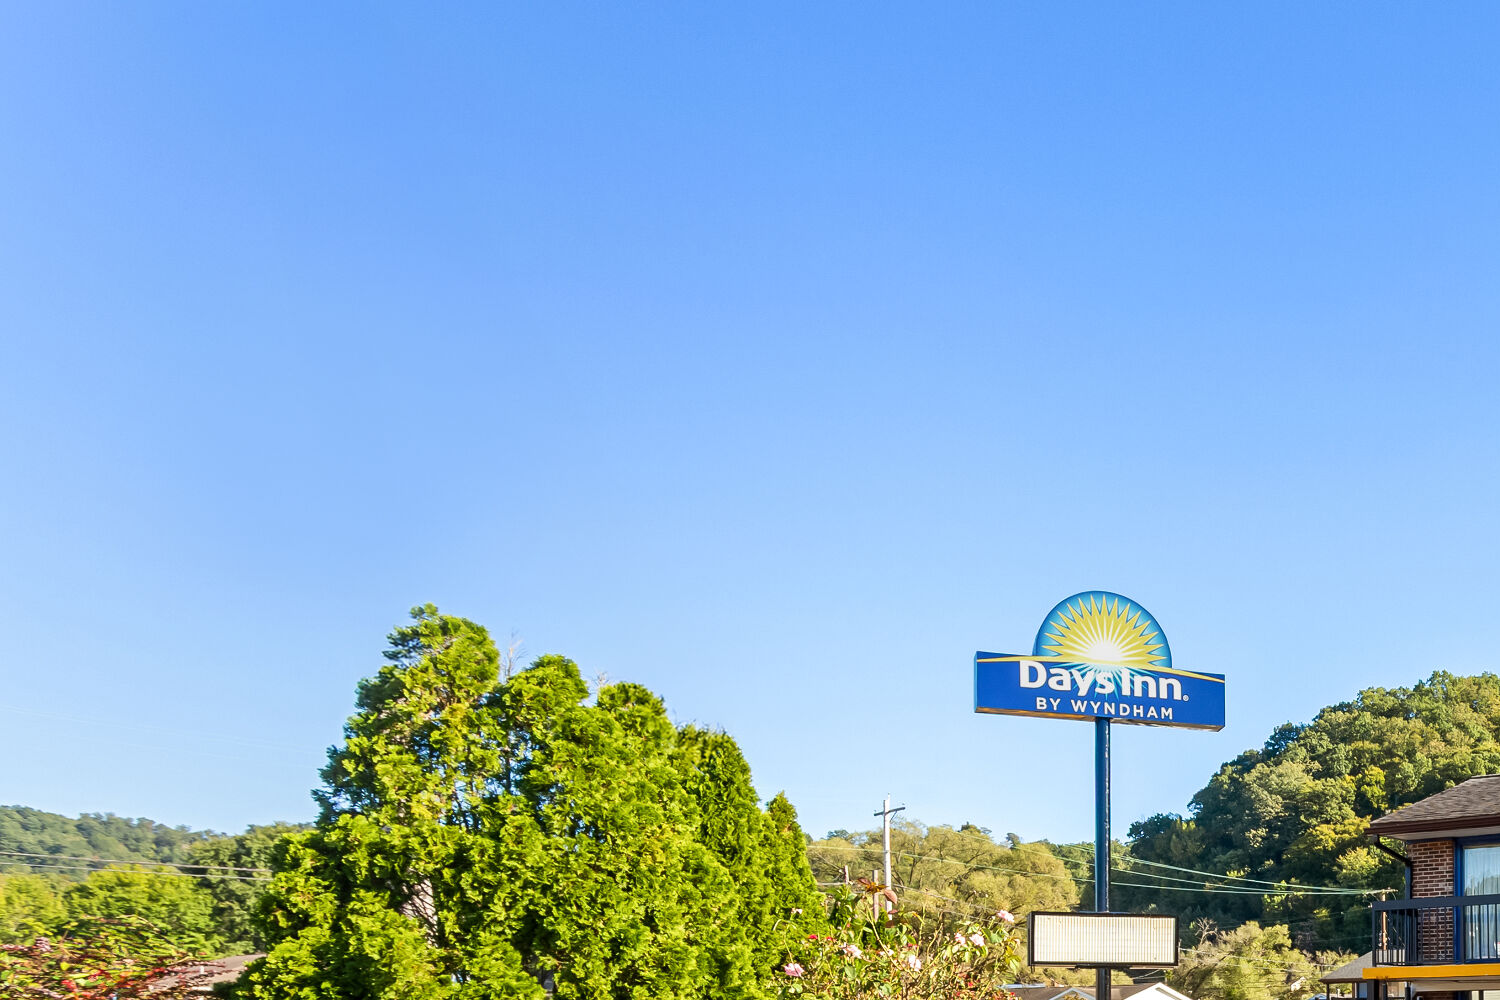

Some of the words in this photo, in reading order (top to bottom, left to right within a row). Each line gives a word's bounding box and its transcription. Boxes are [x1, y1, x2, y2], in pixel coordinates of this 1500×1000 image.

[1019, 660, 1116, 697] Days
[1036, 697, 1061, 711] BY
[1071, 700, 1173, 720] WYNDHAM
